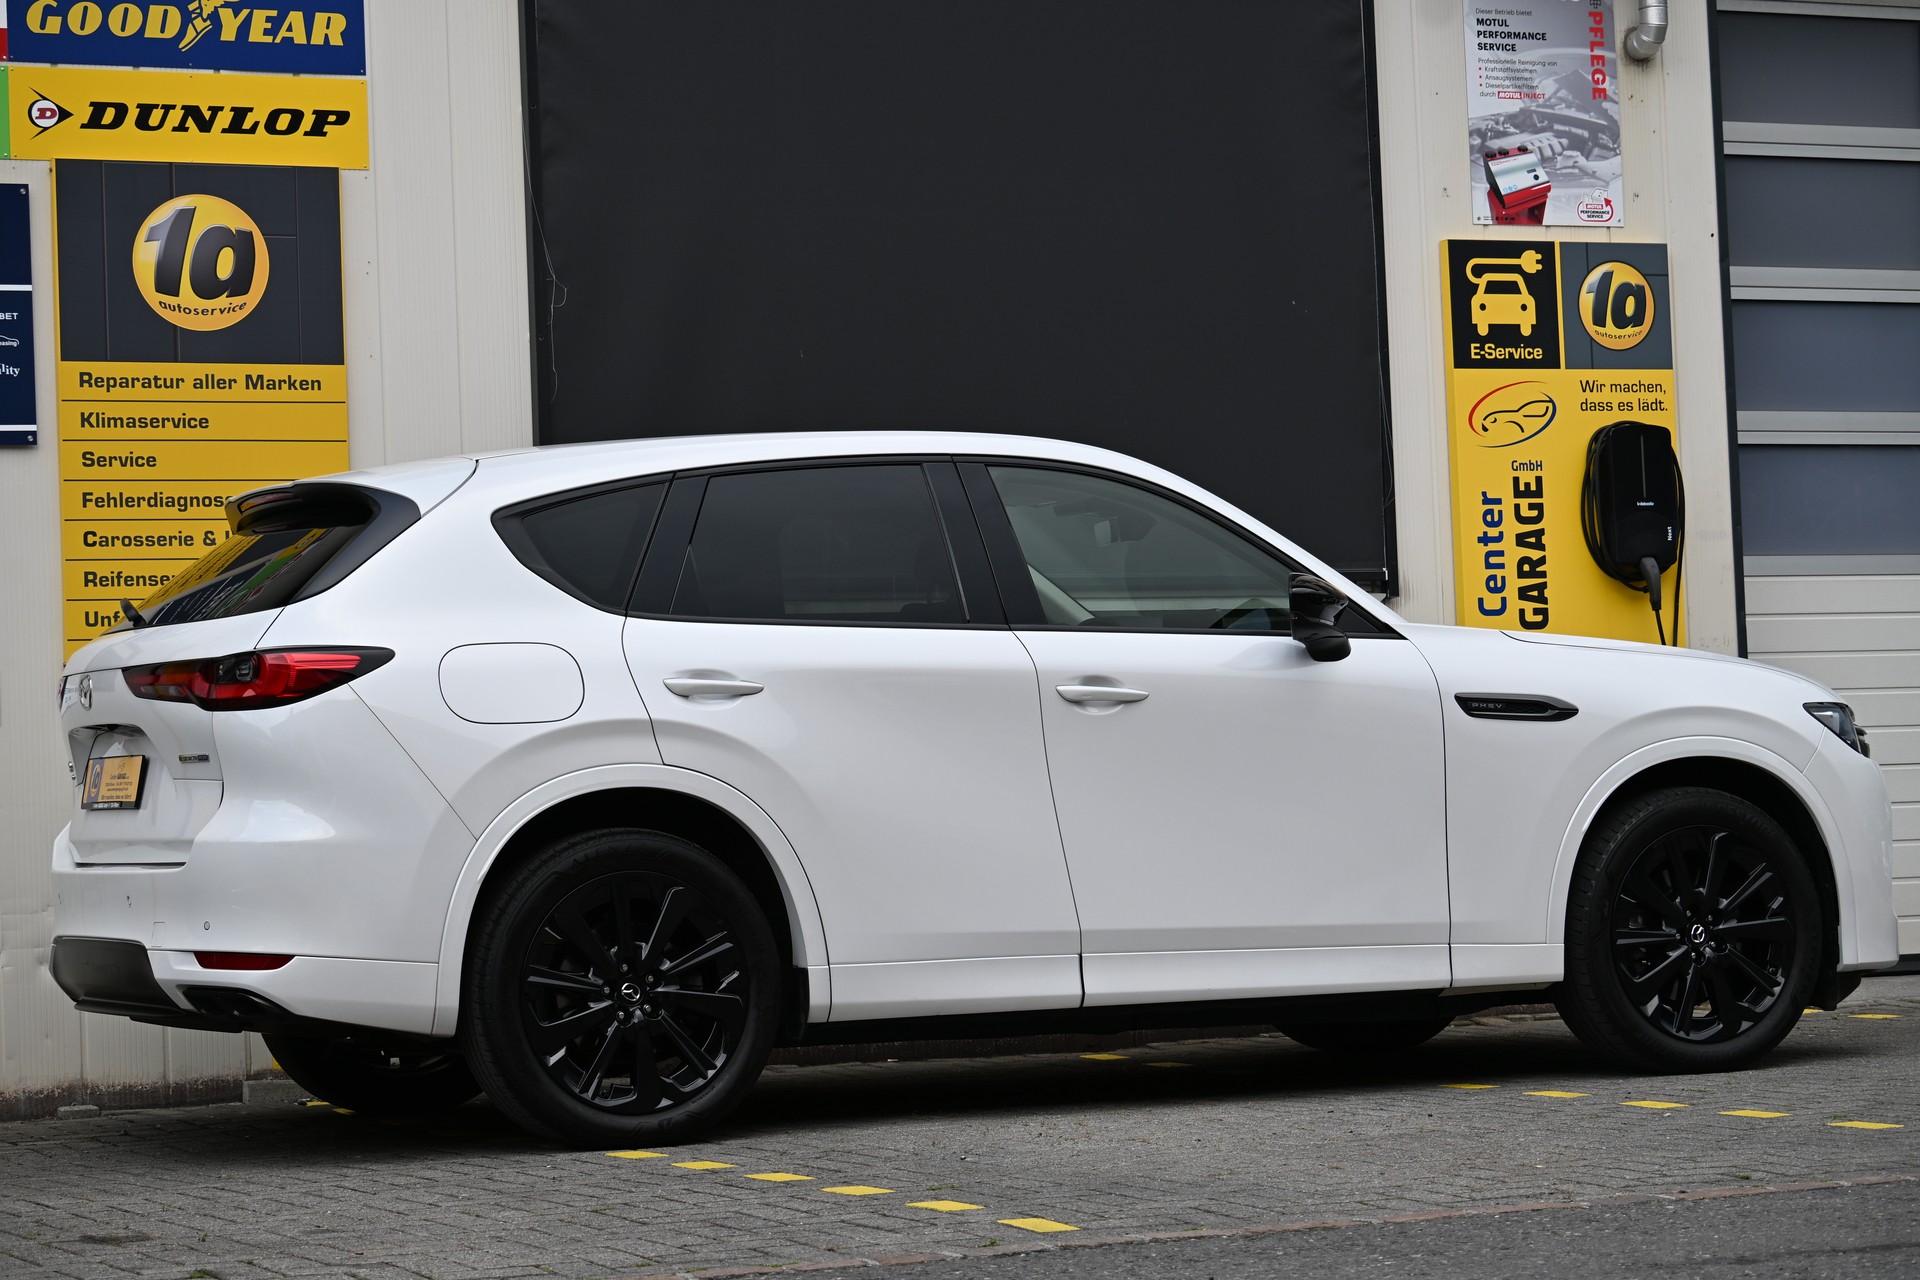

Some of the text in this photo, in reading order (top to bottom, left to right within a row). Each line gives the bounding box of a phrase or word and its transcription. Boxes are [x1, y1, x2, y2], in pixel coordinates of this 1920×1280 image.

[1477, 18, 1509, 27] MOTUL
[1477, 30, 1547, 41] PERFORMANCE
[1478, 42, 1517, 52] SERVICE
[1518, 59, 1546, 67] Reinigung
[1588, 11, 1607, 100] PFLEGE
[1485, 66, 1537, 74] Kraftstoffsystemen
[80, 101, 350, 137] DUNLOP
[144, 206, 256, 300] 1a
[1586, 270, 1647, 329] 1a
[159, 301, 247, 316] autoservice
[1594, 329, 1643, 340] autoservice
[1470, 343, 1543, 359] E-Service
[79, 372, 322, 392] Reparatur aller Marken
[1580, 380, 1666, 394] Wir machen,
[1580, 398, 1668, 412] dass es lädt.
[80, 412, 210, 429] Klimaservice
[81, 451, 157, 468] Service
[1511, 460, 1543, 472] GmbH
[82, 492, 234, 512] Fehlerdiagnos
[83, 531, 194, 547] Carosserie
[203, 530, 217, 546] &
[1478, 491, 1507, 617] Center
[1512, 475, 1549, 631] GARAGE
[84, 571, 176, 587] Reifense
